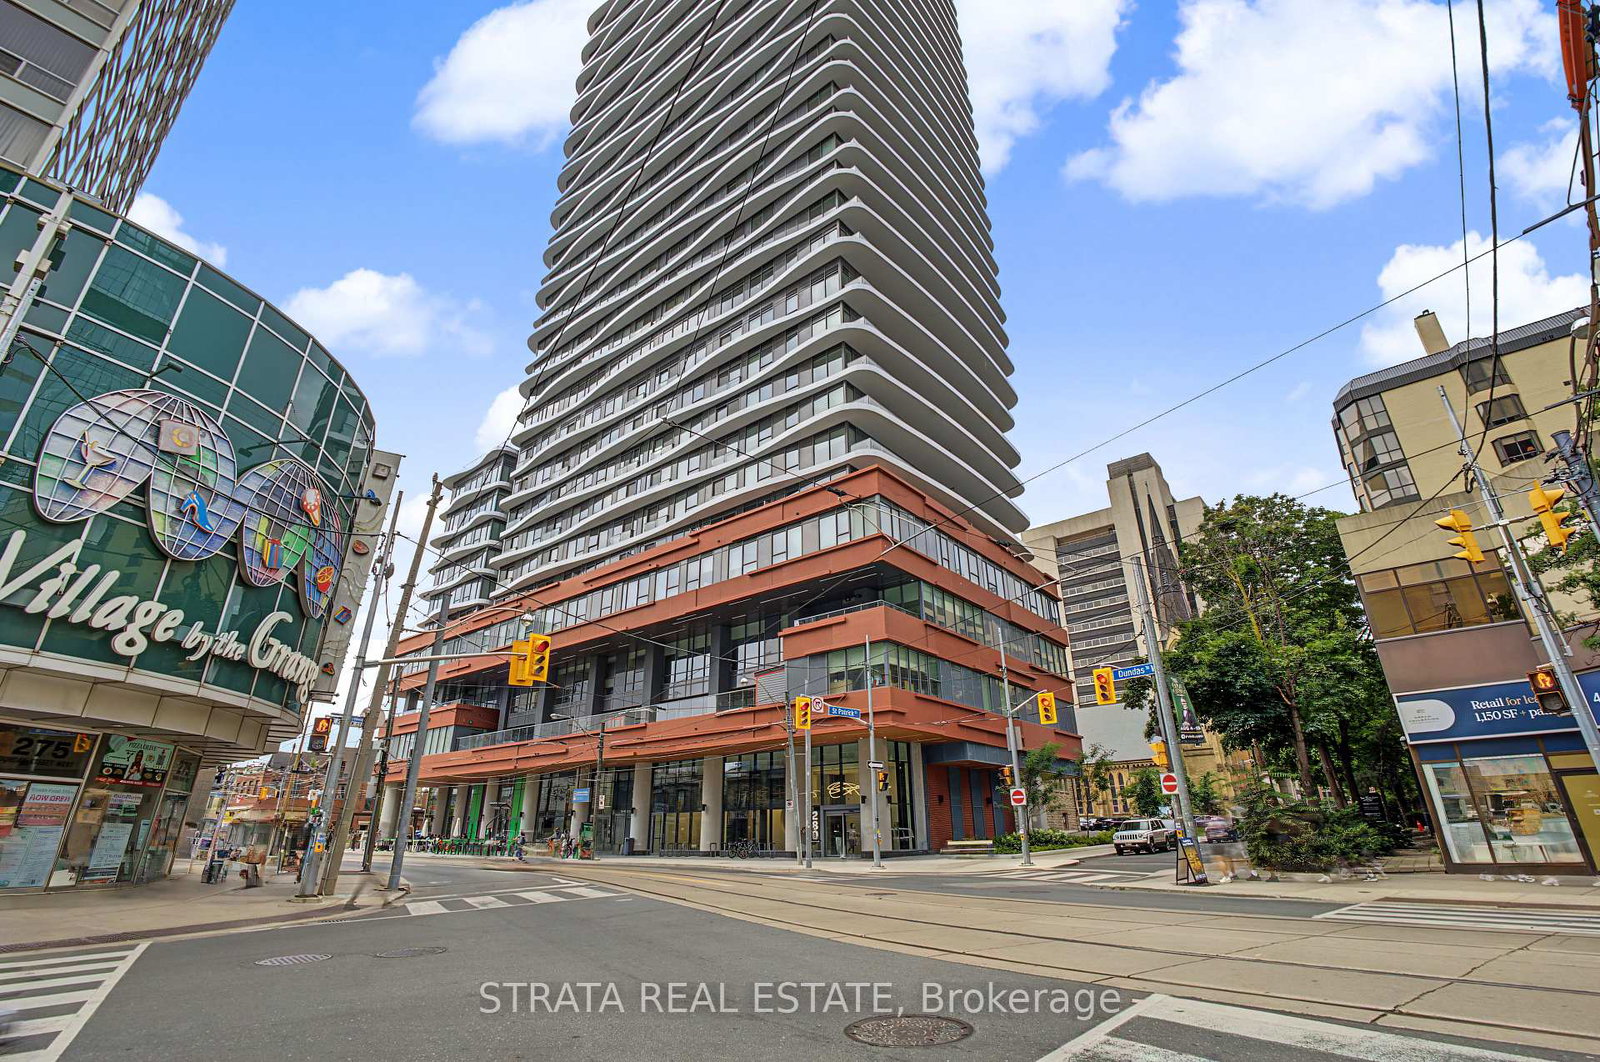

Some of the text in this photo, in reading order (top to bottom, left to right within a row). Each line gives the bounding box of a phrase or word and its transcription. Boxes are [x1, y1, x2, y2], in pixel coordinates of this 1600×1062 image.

[0, 529, 320, 705] Village by the Grange
[1118, 667, 1145, 678] Dundas
[1471, 697, 1505, 710] Retail
[1505, 696, 1521, 706] for
[838, 708, 854, 716] Patrick
[1475, 709, 1502, 723] 1,150
[1503, 708, 1518, 719] SF
[12, 737, 71, 759] 275
